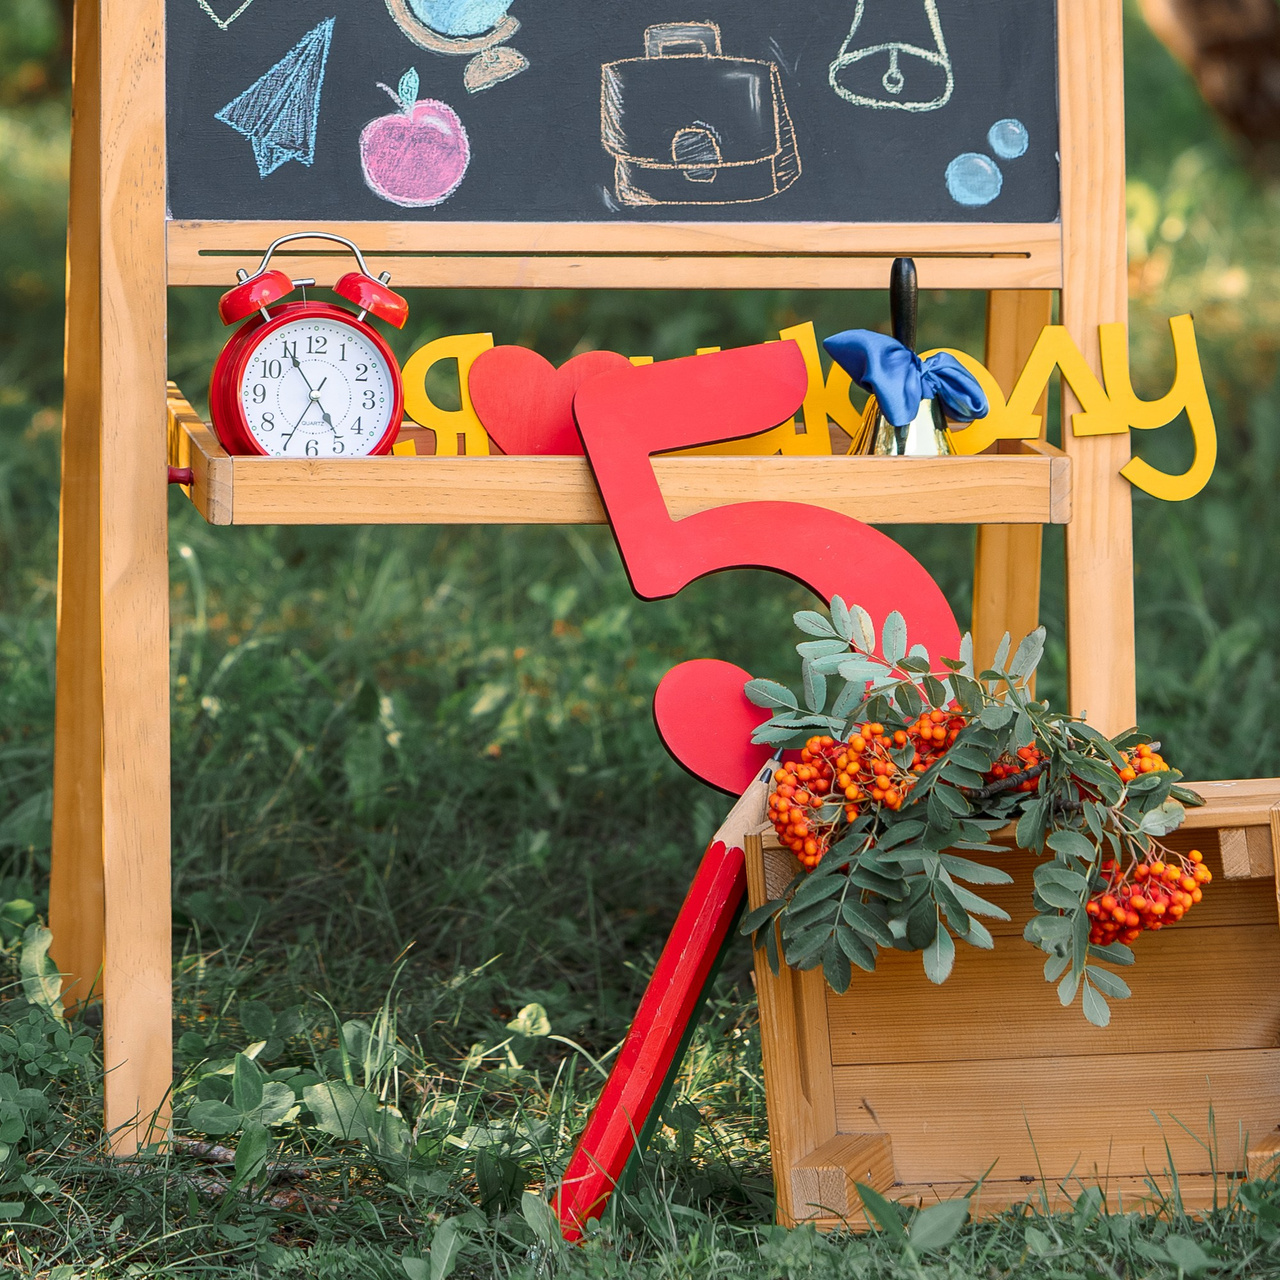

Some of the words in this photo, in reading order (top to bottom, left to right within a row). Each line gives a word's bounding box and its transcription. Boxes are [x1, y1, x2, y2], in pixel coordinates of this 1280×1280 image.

[281, 339, 298, 360] 11
[306, 335, 328, 355] 12
[339, 343, 348, 362] 1
[260, 359, 282, 379] 10
[355, 363, 369, 382] 2
[252, 383, 267, 404] 9
[362, 389, 376, 410] 3
[260, 412, 275, 432] 8
[350, 416, 364, 435] 4
[280, 433, 292, 451] 7
[305, 439, 319, 456] 6
[332, 435, 345, 454] 5
[575, 339, 963, 796] 5
